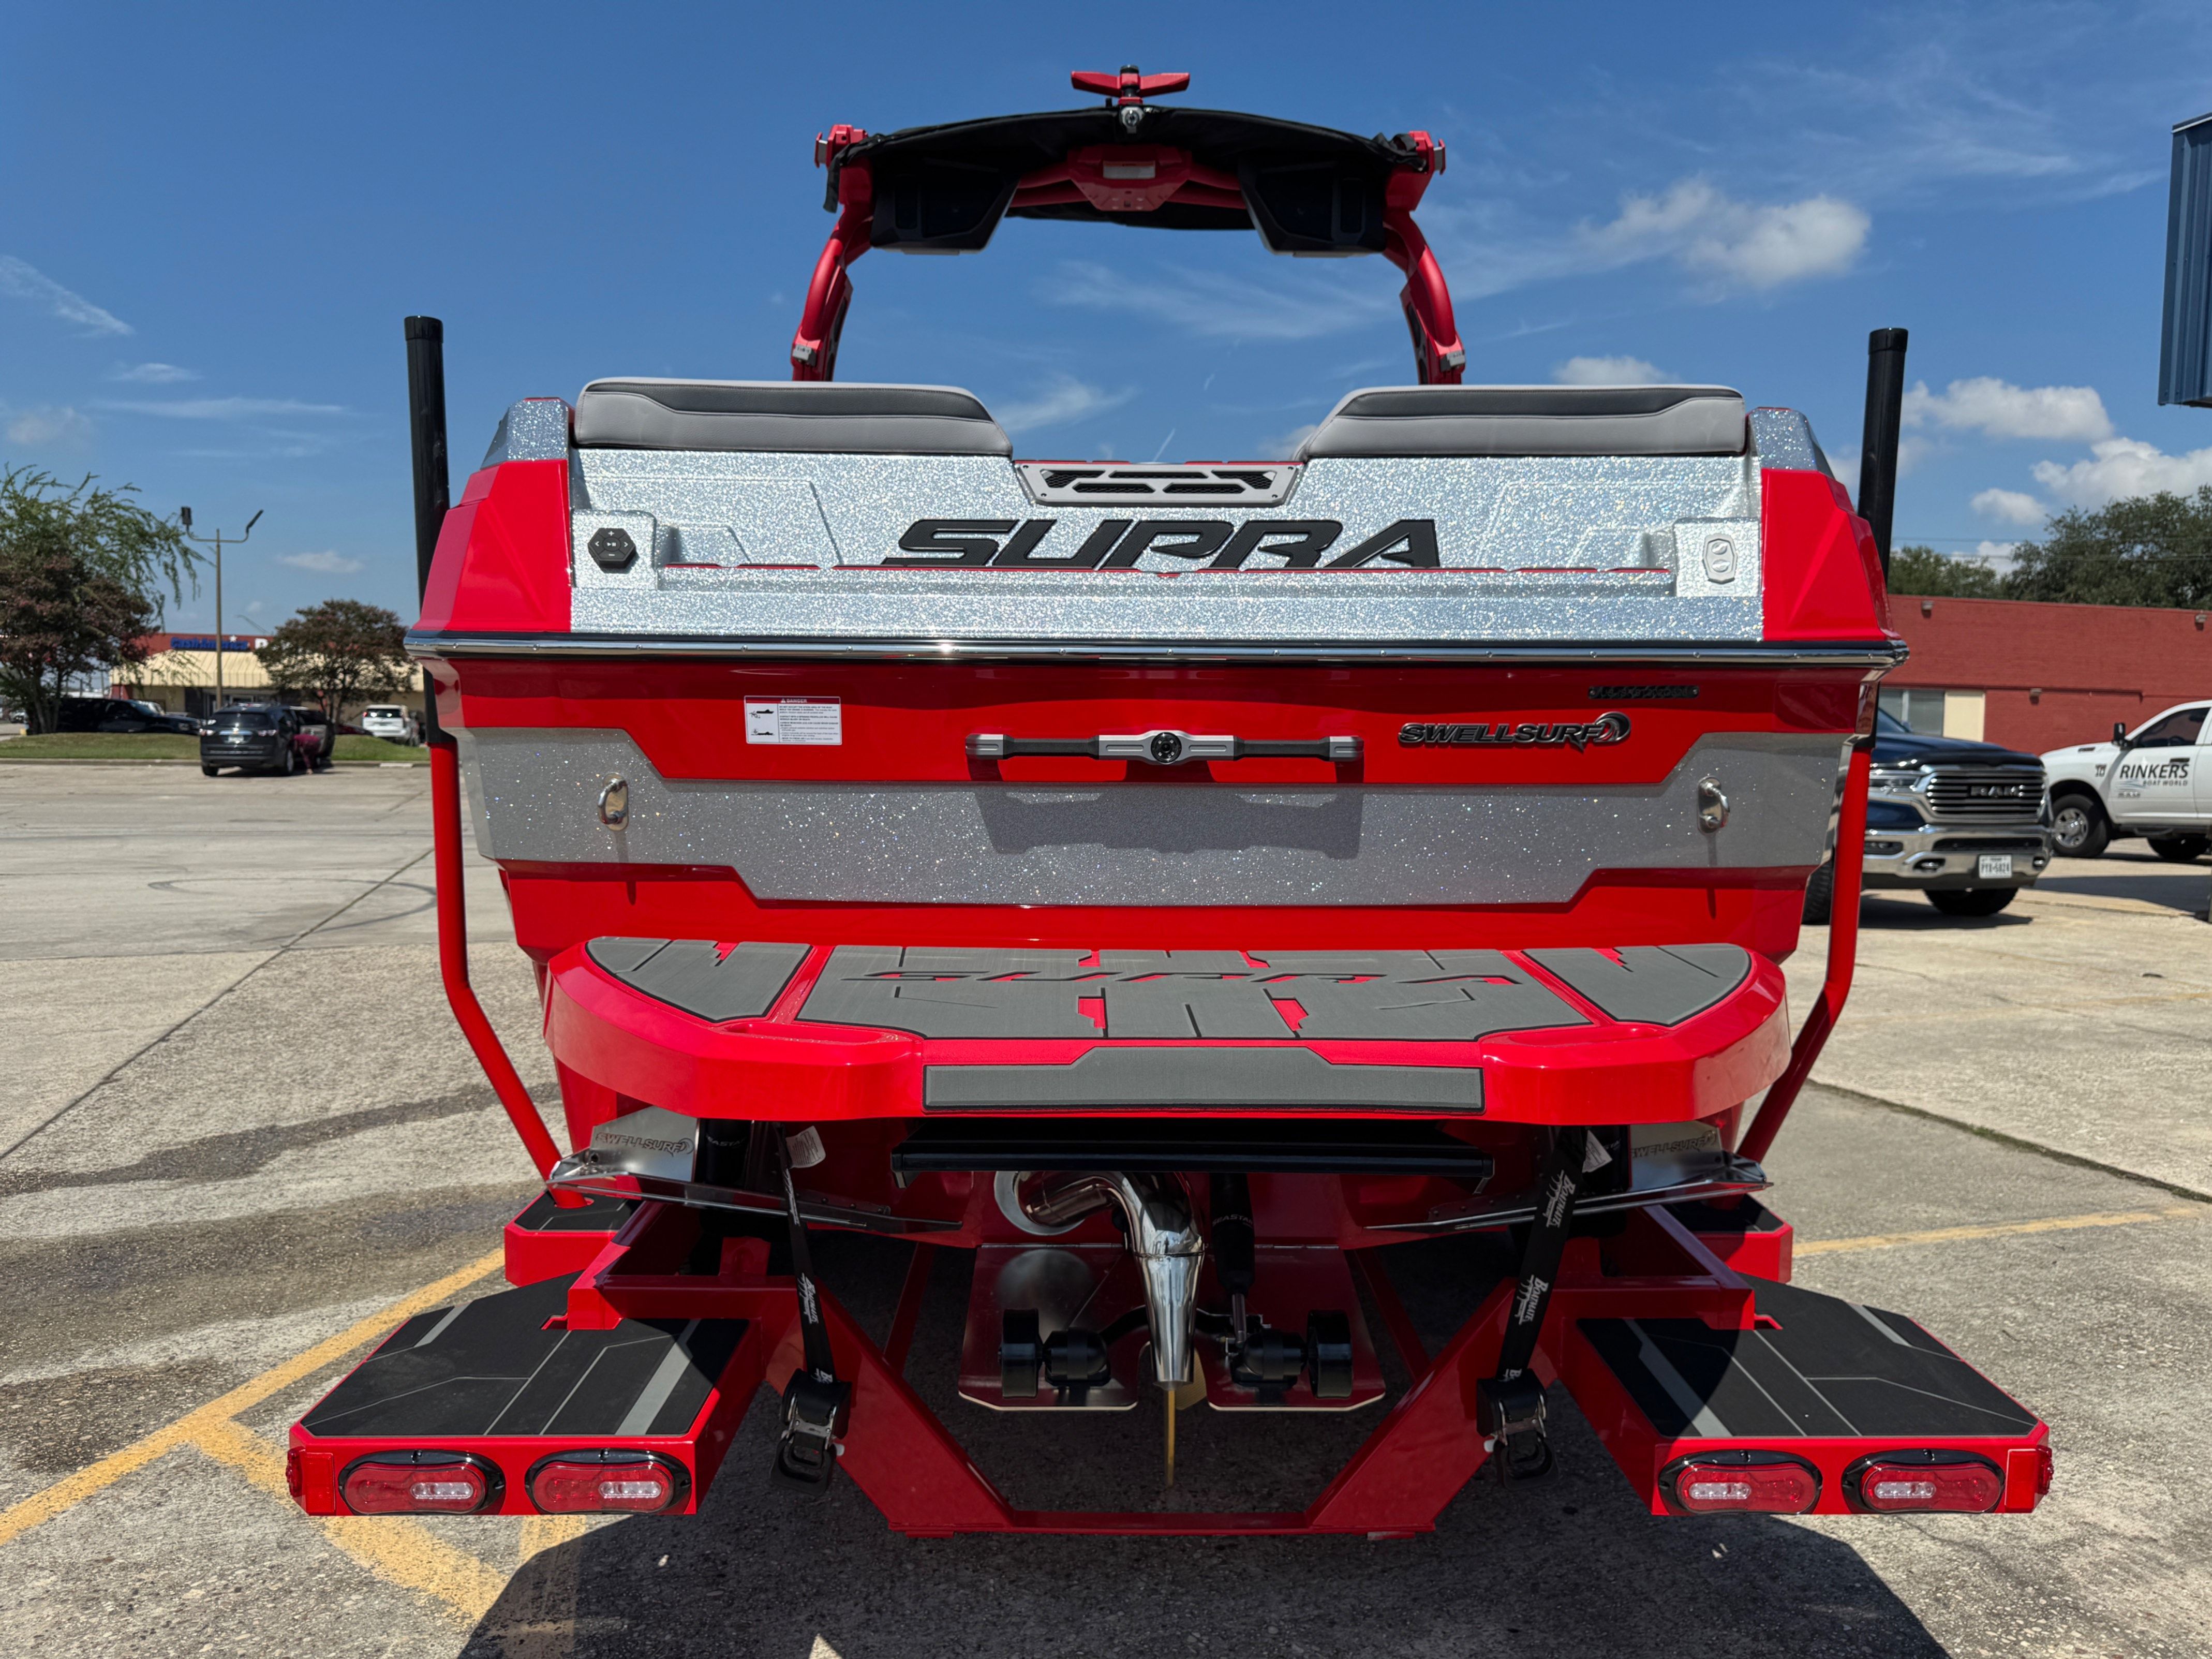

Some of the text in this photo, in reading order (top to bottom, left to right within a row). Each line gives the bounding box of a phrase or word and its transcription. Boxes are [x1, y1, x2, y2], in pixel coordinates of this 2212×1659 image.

[883, 518, 1441, 570] SUPRA
[1398, 722, 1608, 751] SWELLSURF
[2119, 764, 2189, 779] RINKERS
[1970, 786, 2022, 796] RAM
[596, 1132, 685, 1156] SWELLSURF
